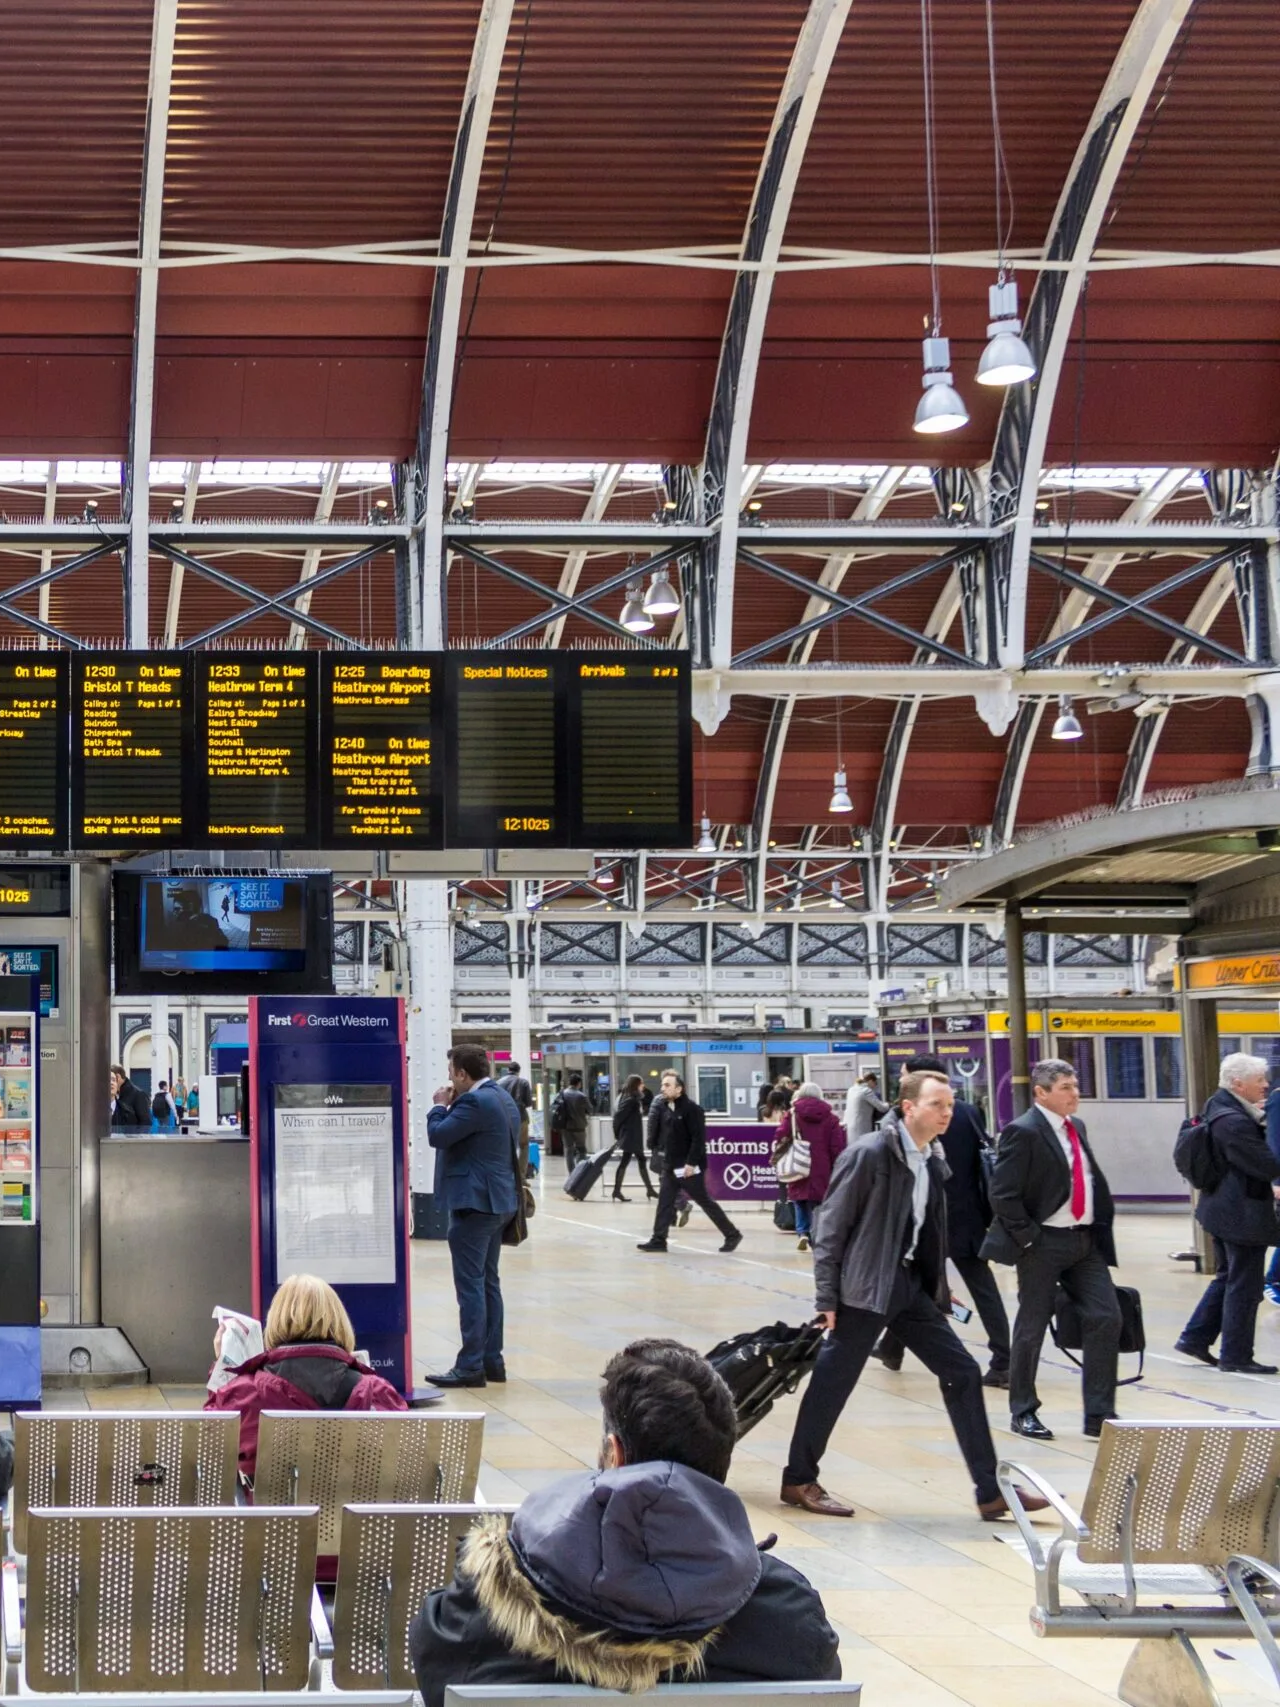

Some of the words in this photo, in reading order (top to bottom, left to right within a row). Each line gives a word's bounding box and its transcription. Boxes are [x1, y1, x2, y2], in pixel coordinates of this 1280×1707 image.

[15, 665, 30, 678] On
[33, 666, 57, 678] time
[85, 665, 116, 678] 12:30
[139, 665, 155, 678] On
[158, 665, 181, 678] time
[210, 665, 241, 677] 12:33
[263, 665, 279, 677] On
[282, 665, 306, 677] time
[334, 666, 366, 678] 12:25
[381, 666, 431, 680] Boarding
[463, 666, 503, 680] Special
[506, 666, 548, 678] Notices
[580, 664, 626, 677] Arrivals
[83, 681, 122, 693] Bristol
[125, 680, 134, 693] T
[137, 681, 172, 693] Meads
[208, 680, 256, 693] Heathrow
[258, 680, 284, 693] Term
[286, 680, 294, 692] 4
[332, 681, 386, 693] Heathrow
[389, 681, 431, 695] Airport
[334, 737, 365, 750] 12:40
[388, 737, 404, 750] On
[406, 737, 431, 750] time
[332, 752, 386, 765] Heathrow
[388, 752, 431, 766] Airport
[240, 882, 258, 891] SEE
[259, 882, 271, 891] IT.
[239, 891, 258, 900] SAY
[259, 891, 270, 900] IT.
[239, 899, 282, 909] SORTED.
[13, 951, 25, 959] SEE
[268, 1014, 292, 1026] First
[307, 1014, 339, 1027] Great
[340, 1014, 389, 1027] Western
[1064, 1016, 1094, 1028] Flight
[1095, 1016, 1156, 1028] Information
[323, 1094, 344, 1105] GWR
[281, 1115, 314, 1127] When
[317, 1117, 338, 1127] can
[340, 1115, 345, 1127] I
[347, 1115, 386, 1127] travel?
